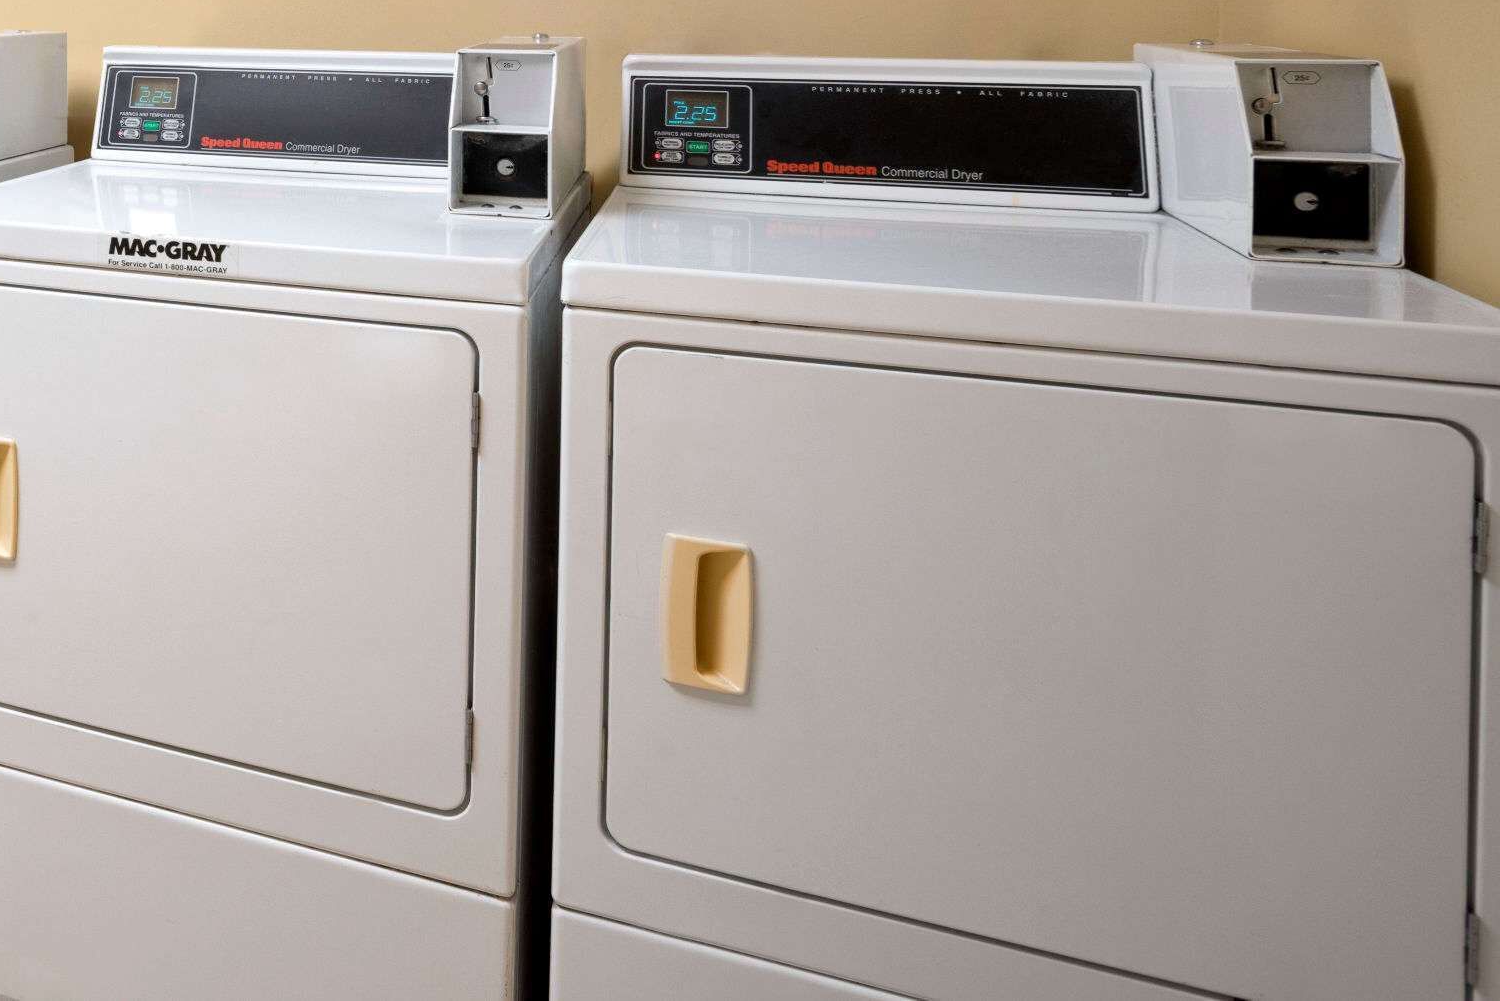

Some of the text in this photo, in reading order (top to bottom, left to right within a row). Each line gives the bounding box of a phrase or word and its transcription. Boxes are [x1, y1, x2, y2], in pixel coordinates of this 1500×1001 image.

[241, 73, 297, 81] PERMANENT
[811, 86, 885, 94] PERMANENT
[901, 88, 941, 96] PRESS
[1020, 91, 1069, 99] FABRIC
[674, 105, 717, 121] 2.25
[202, 136, 361, 155] Speed Queen Commercial Dryer
[767, 159, 984, 182] Speed Queen Commercial Dryer
[109, 258, 228, 274] For Service Call 1-800-MAC-GRAY
